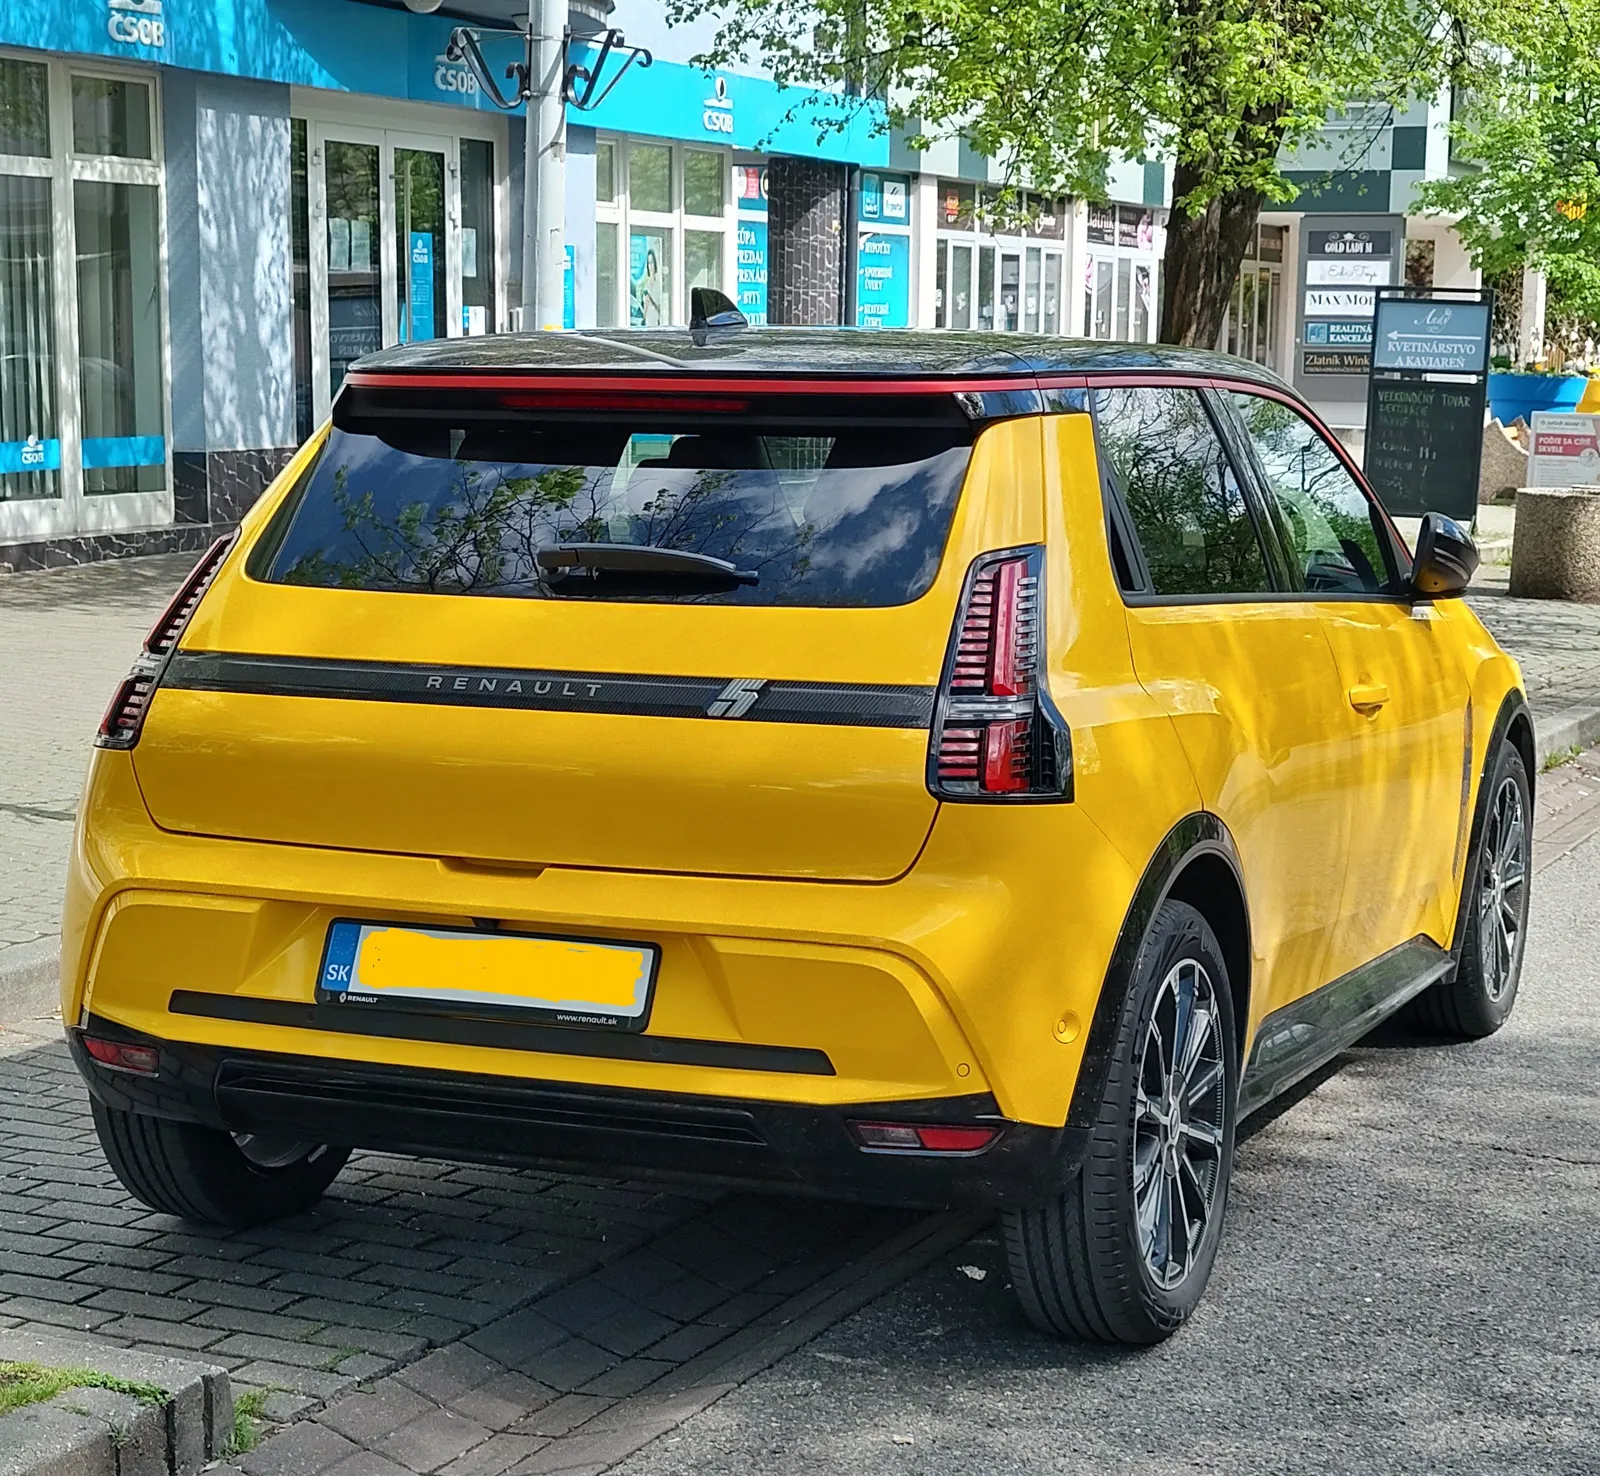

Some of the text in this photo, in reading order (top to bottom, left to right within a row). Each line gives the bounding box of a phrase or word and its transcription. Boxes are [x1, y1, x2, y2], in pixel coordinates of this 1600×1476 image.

[108, 10, 164, 47] ČSOB
[434, 65, 476, 94] ČSOB
[702, 108, 733, 133] ČSOB
[1324, 242, 1373, 254] GOLD LADY M
[413, 253, 428, 264] ČSOB
[1309, 294, 1340, 306] MAX
[1329, 323, 1372, 334] REALITNÁ
[1387, 340, 1476, 355] KVETINÁRSTVO
[1305, 354, 1341, 366] Zlatník
[1394, 356, 1466, 368] A KAVIAREŇ
[1441, 393, 1471, 408] TOVAR
[1563, 437, 1573, 445] SA
[1537, 445, 1564, 453] SKVELE
[21, 451, 44, 465] ČSOB
[426, 675, 602, 698] RENAULT
[326, 963, 350, 982] SK
[347, 995, 378, 1004] RENAULT
[556, 1012, 618, 1026] www.renault.sk
